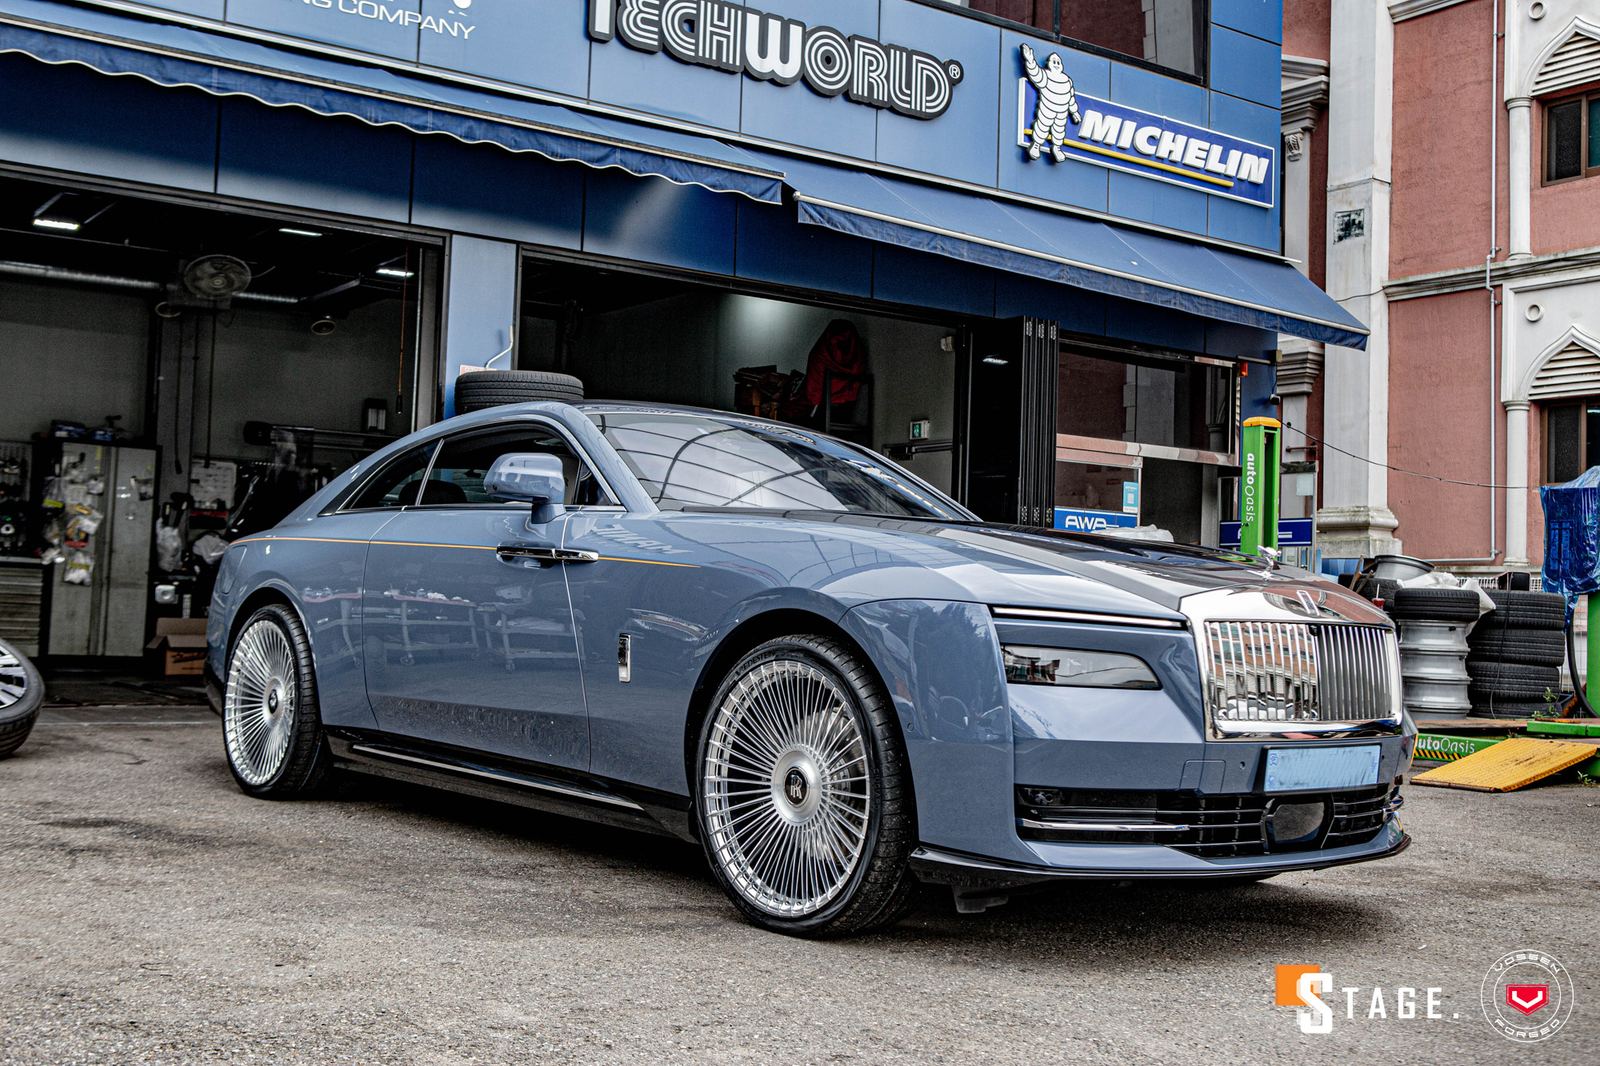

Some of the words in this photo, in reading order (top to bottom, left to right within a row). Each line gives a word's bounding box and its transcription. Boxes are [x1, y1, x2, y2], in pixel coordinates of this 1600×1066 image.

[338, 0, 476, 40] COMPANY
[1078, 109, 1269, 185] MICHELIN
[1244, 452, 1257, 522] autoOasis
[1417, 736, 1475, 754] utoOasis
